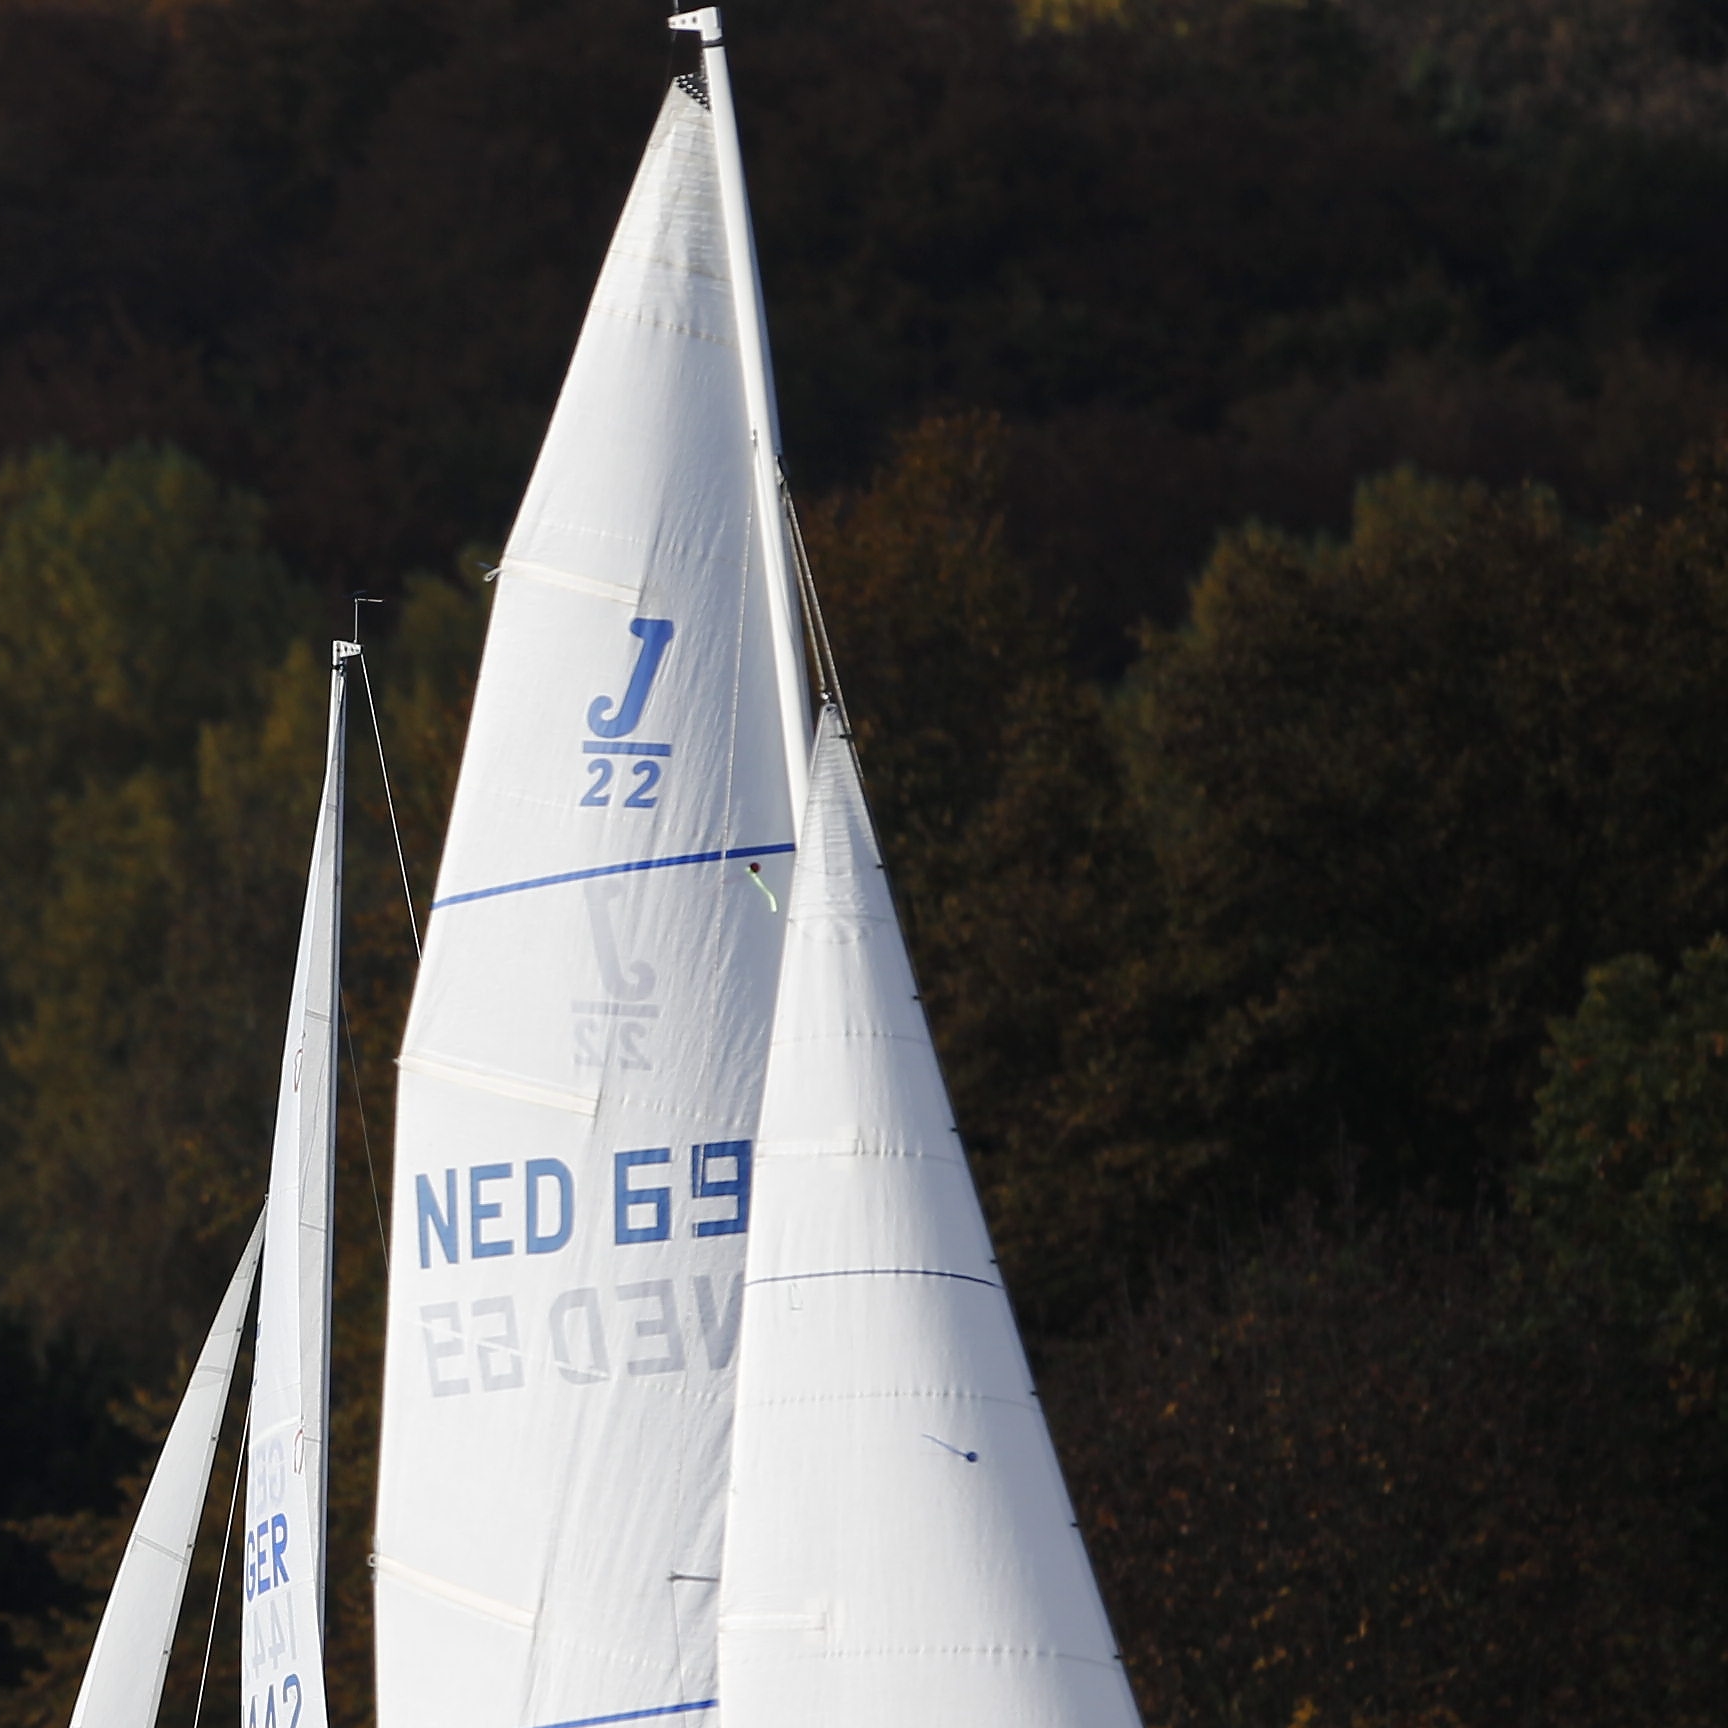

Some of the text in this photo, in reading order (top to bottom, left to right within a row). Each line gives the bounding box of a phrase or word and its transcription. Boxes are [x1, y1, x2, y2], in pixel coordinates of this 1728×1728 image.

[587, 618, 674, 738] J
[580, 758, 661, 808] 22
[414, 1140, 752, 1270] NED 69
[246, 1513, 289, 1602] GER
